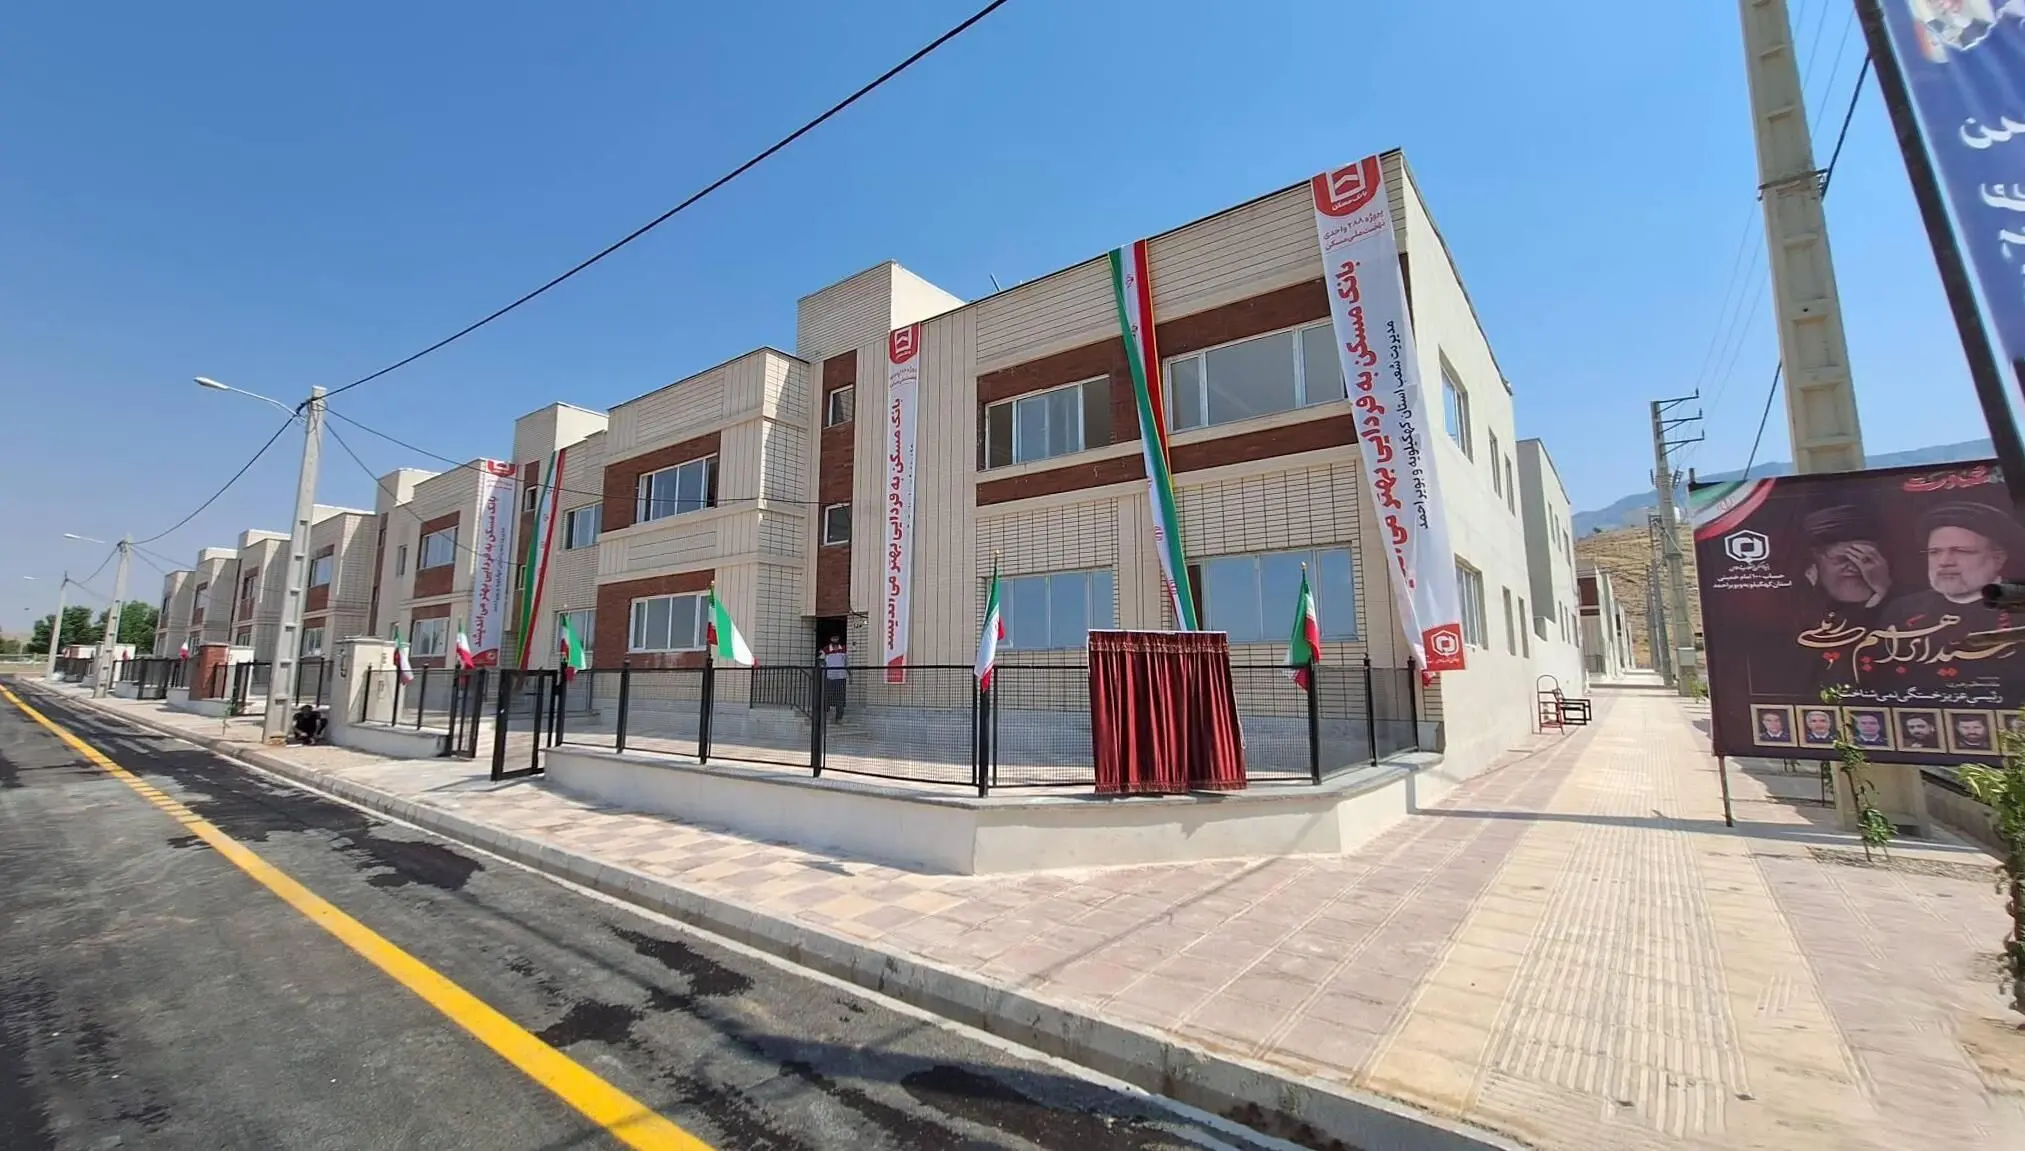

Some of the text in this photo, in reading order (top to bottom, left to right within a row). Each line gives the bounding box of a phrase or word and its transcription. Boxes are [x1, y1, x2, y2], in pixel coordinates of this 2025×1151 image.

[1364, 208, 1384, 223] پروژه
[1322, 224, 1348, 240] واحدی
[1336, 261, 1360, 304] بانک
[1345, 306, 1377, 366] مسکن
[1386, 320, 1402, 359] مدیریت
[1355, 371, 1379, 391] به
[1389, 360, 1407, 388] شعب
[891, 398, 903, 429] بانک
[1393, 389, 1412, 419] استان
[1356, 395, 1393, 463] فردایی
[1399, 421, 1420, 467] کهگیلویه
[890, 431, 904, 474] مسکن
[890, 477, 904, 490] به
[1373, 467, 1402, 509] بهتر
[487, 496, 497, 514] بانک
[889, 492, 903, 541] فردایی
[485, 515, 496, 542] مسکن
[481, 553, 493, 583] فردایی
[888, 543, 902, 573] بهتر
[480, 583, 491, 602] بهتر
[1771, 580, 1792, 588] استان
[473, 615, 485, 647] اندیشد
[887, 598, 898, 650] اندیشد
[1853, 614, 1960, 684] ابراهیم
[1897, 686, 1941, 702] خستگی
[1939, 692, 1967, 703] عزیز
[1966, 690, 2003, 706] رئیسی
